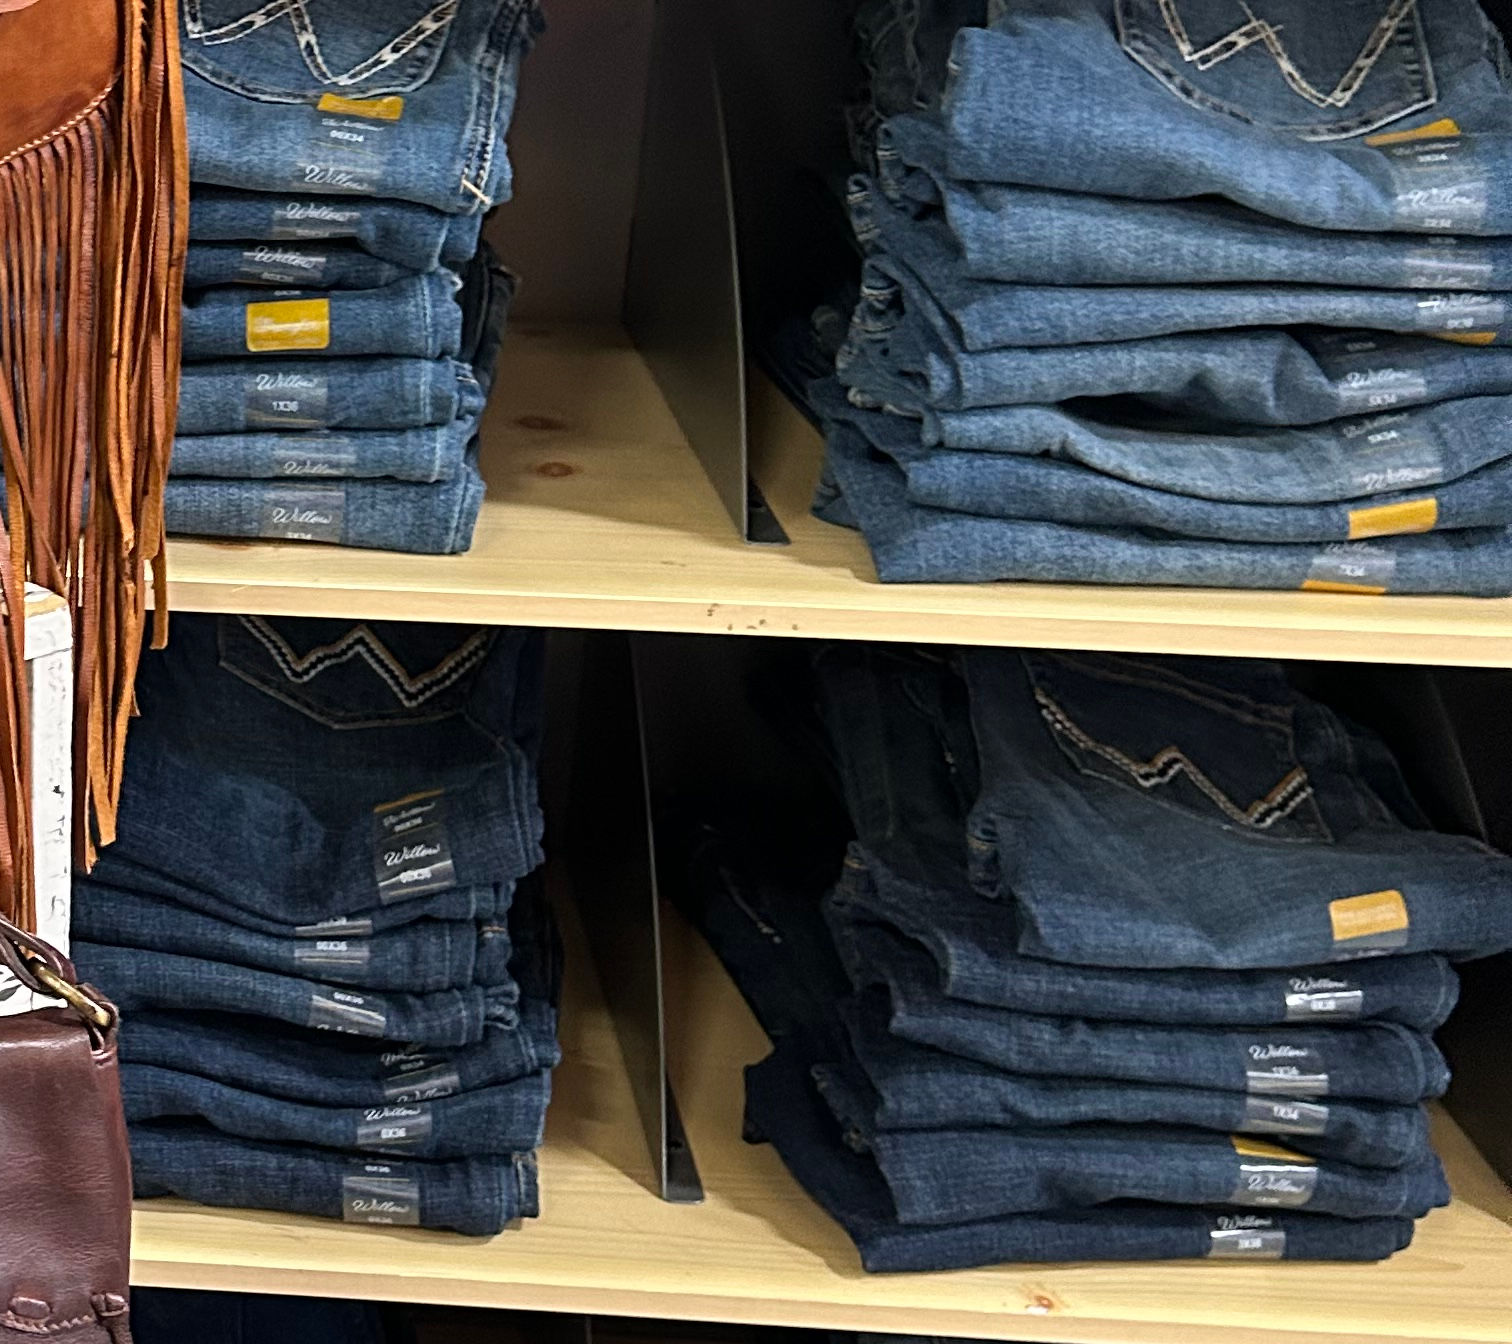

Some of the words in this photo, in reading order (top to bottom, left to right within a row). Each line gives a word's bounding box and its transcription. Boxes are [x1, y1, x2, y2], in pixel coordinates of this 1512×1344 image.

[255, 372, 319, 390] Willow
[272, 507, 333, 524] Willow
[384, 843, 441, 866] Willow
